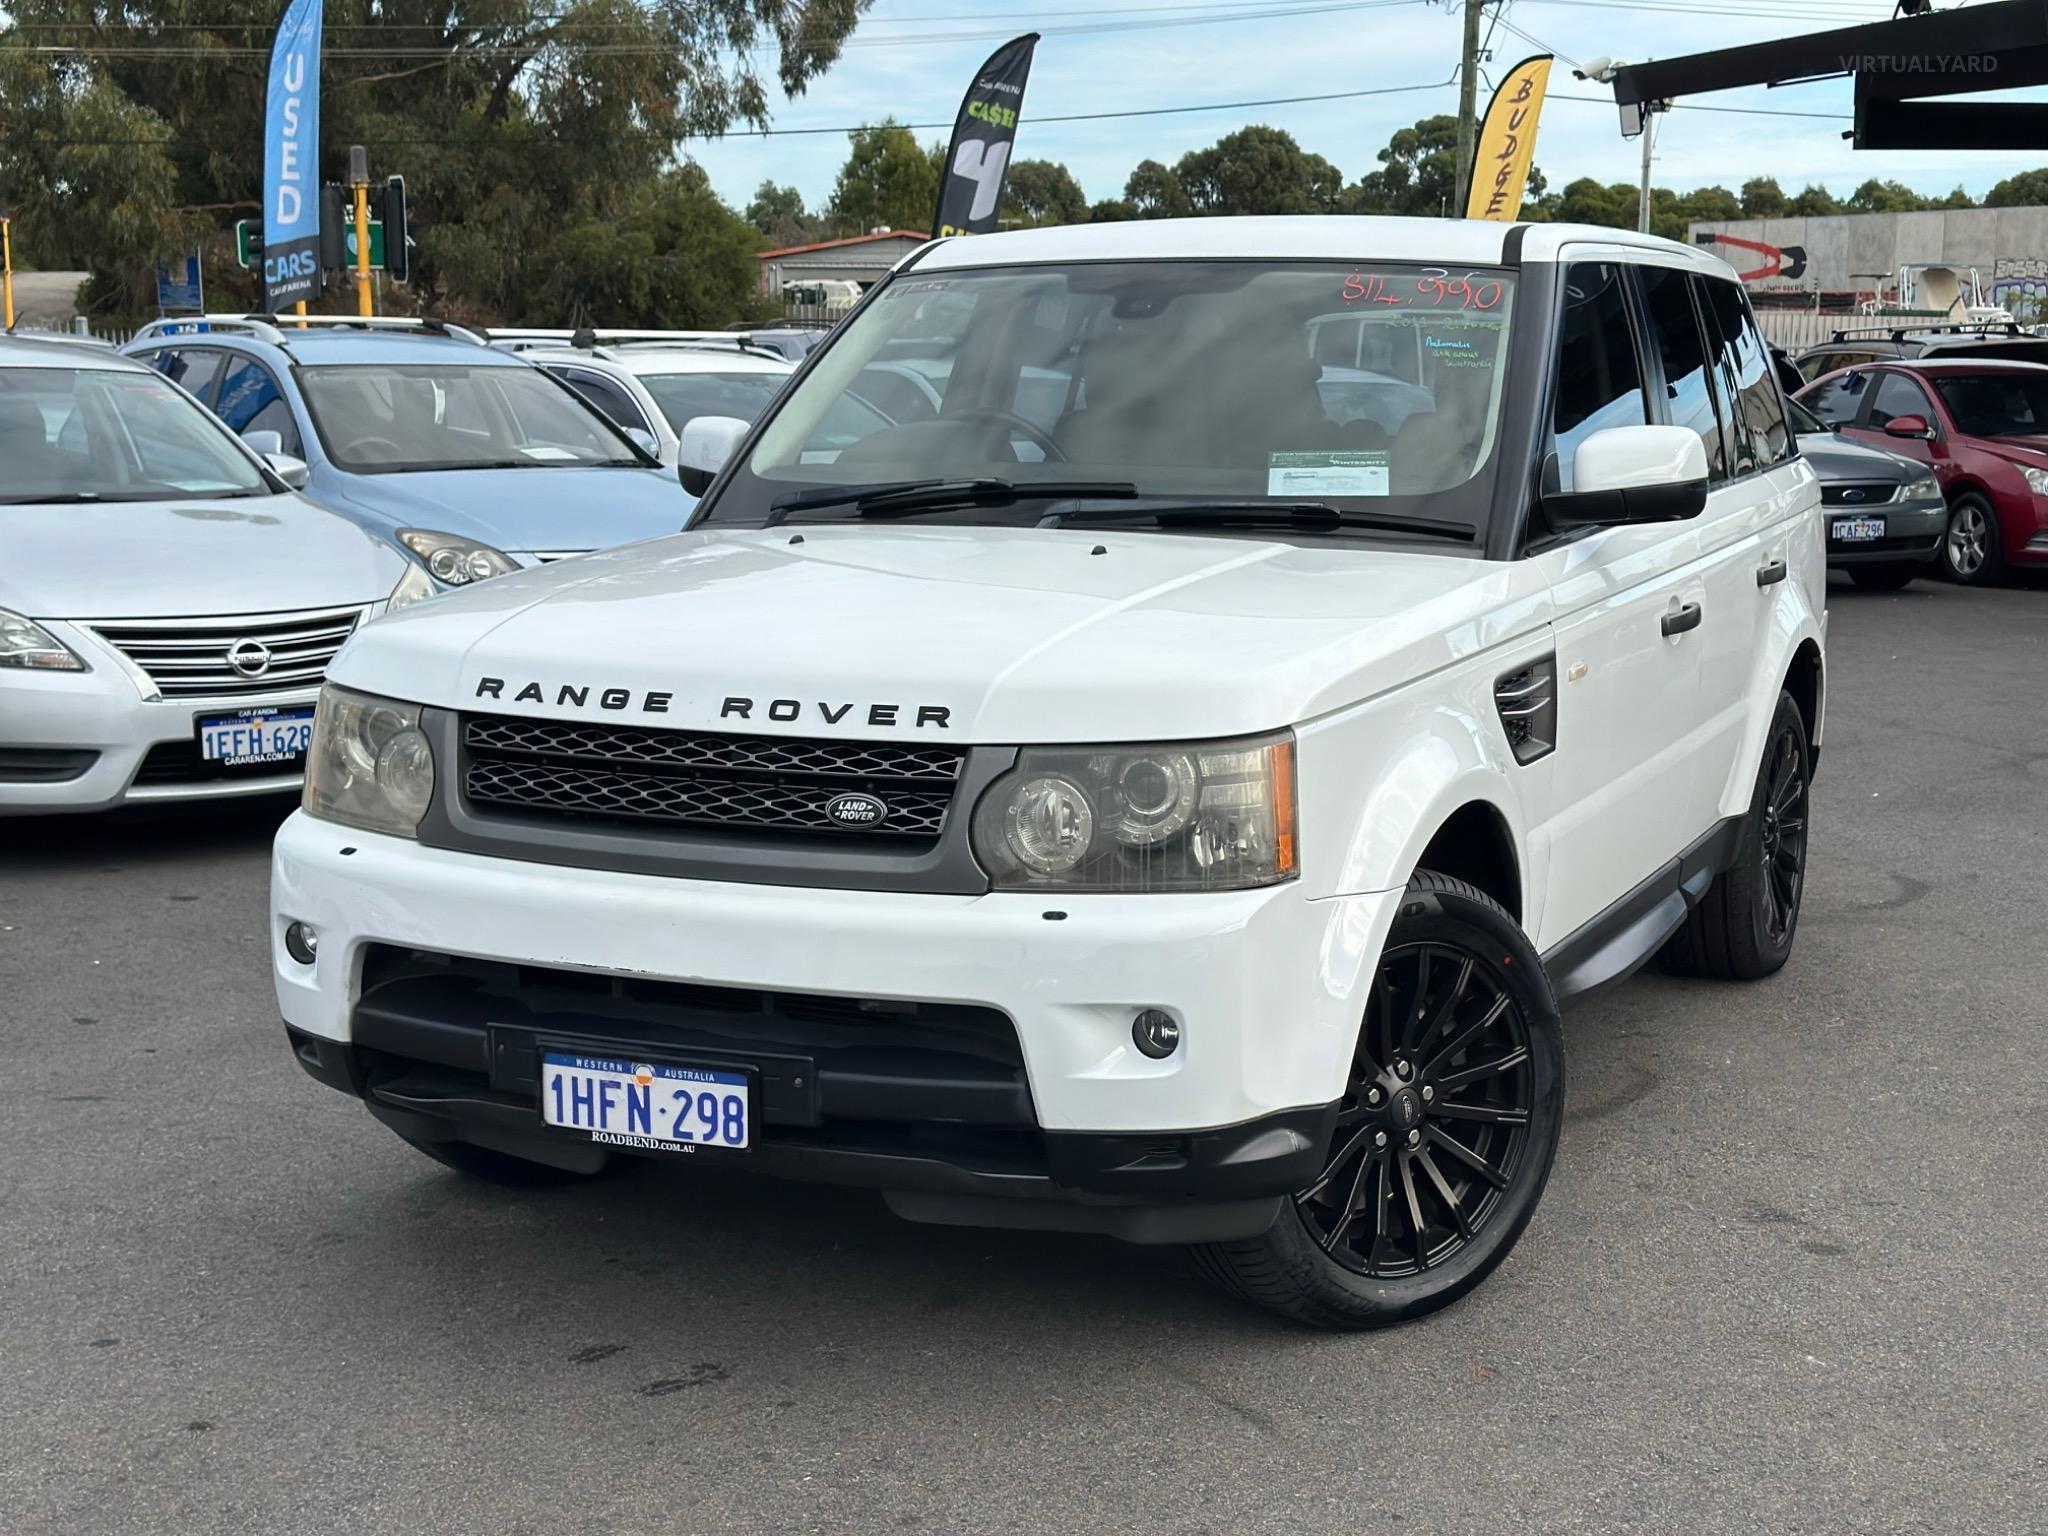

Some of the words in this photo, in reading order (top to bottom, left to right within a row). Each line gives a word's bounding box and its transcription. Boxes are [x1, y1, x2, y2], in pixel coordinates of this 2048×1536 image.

[277, 53, 305, 224] USED
[1485, 78, 1534, 220] BUDGE
[953, 138, 1011, 222] 4
[264, 249, 317, 284] CARS
[475, 677, 674, 713] RANGE
[720, 697, 951, 728] ROVER
[224, 751, 296, 766] CARARENA.COM.AU
[838, 801, 867, 811] LAND
[840, 810, 875, 820] ROVER
[575, 1058, 623, 1073] WESTERN
[664, 1069, 715, 1083] AUSTRALIA
[592, 1131, 696, 1154] ROADBEND.COM.AU
